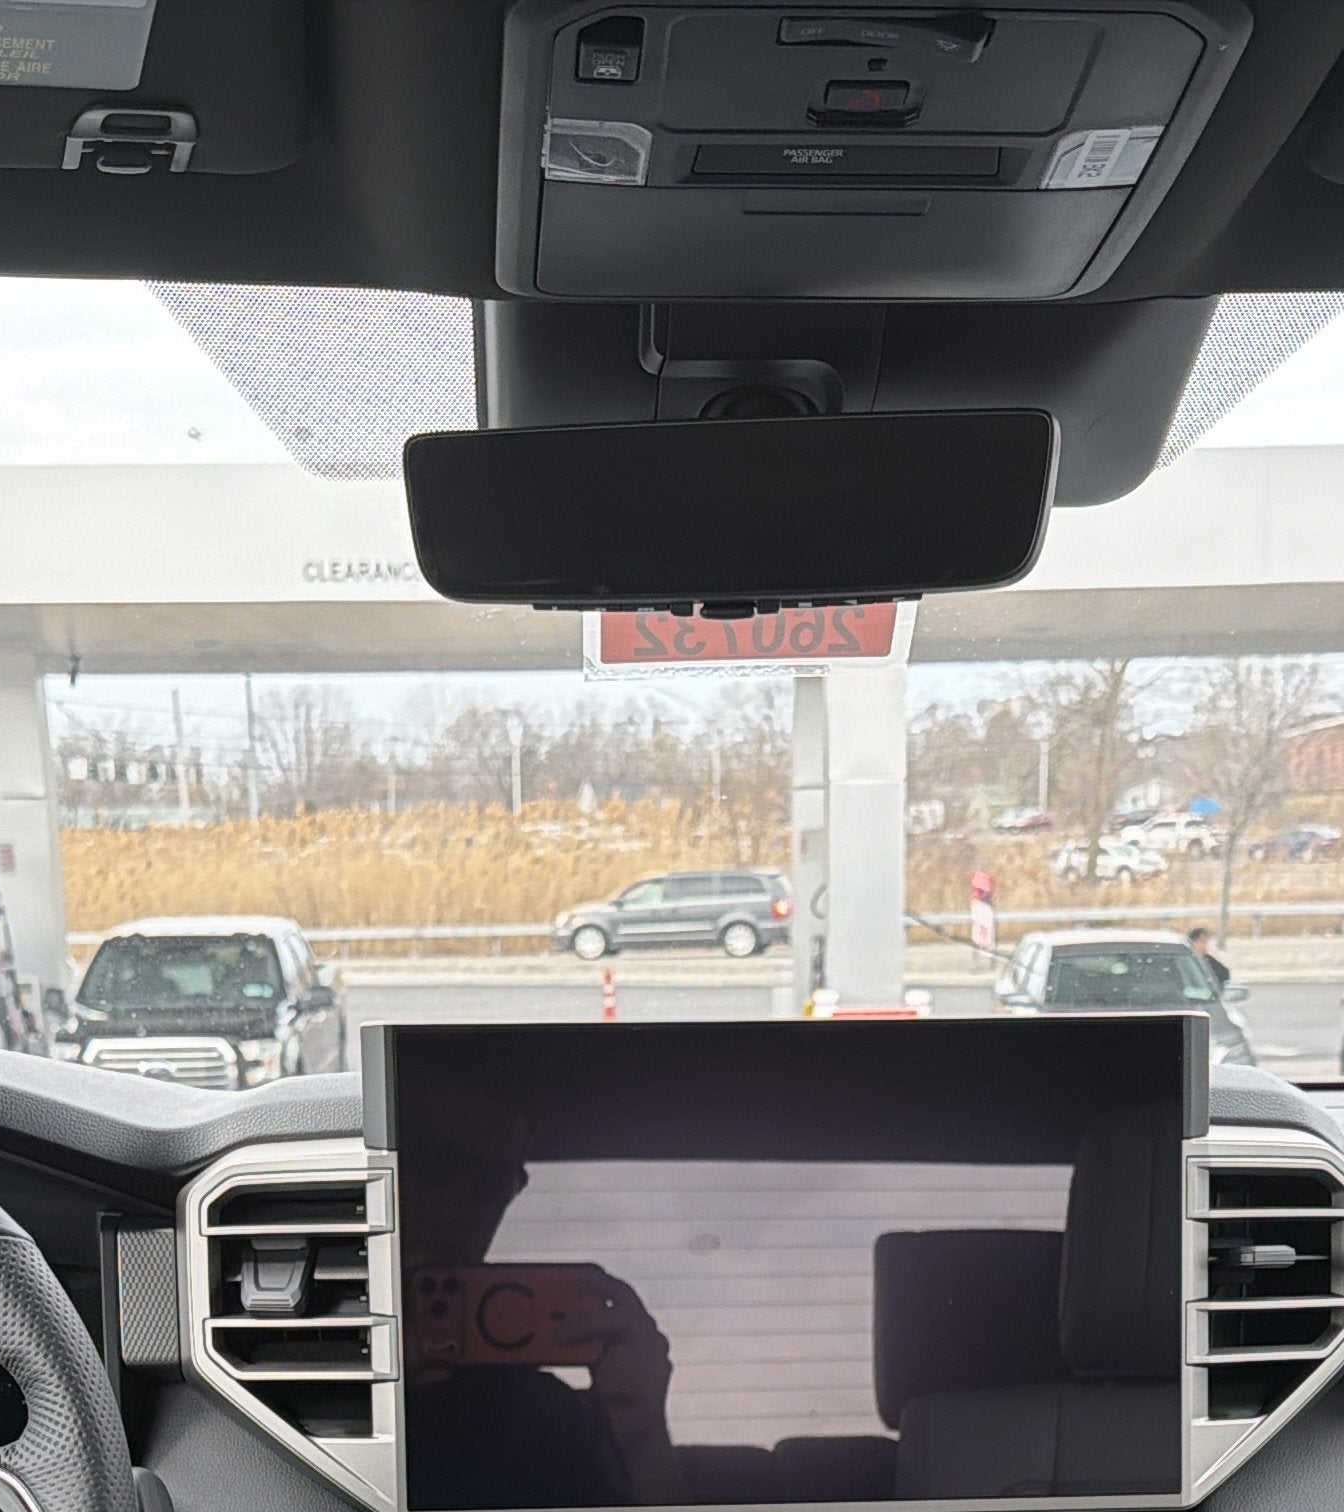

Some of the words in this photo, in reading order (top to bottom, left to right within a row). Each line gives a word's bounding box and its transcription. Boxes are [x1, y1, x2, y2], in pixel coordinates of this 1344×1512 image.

[16, 61, 53, 75] AIRE
[782, 149, 844, 157] PASSENGER
[790, 156, 808, 164] AIR
[811, 156, 833, 165] BAG
[302, 561, 421, 583] CLEARANC
